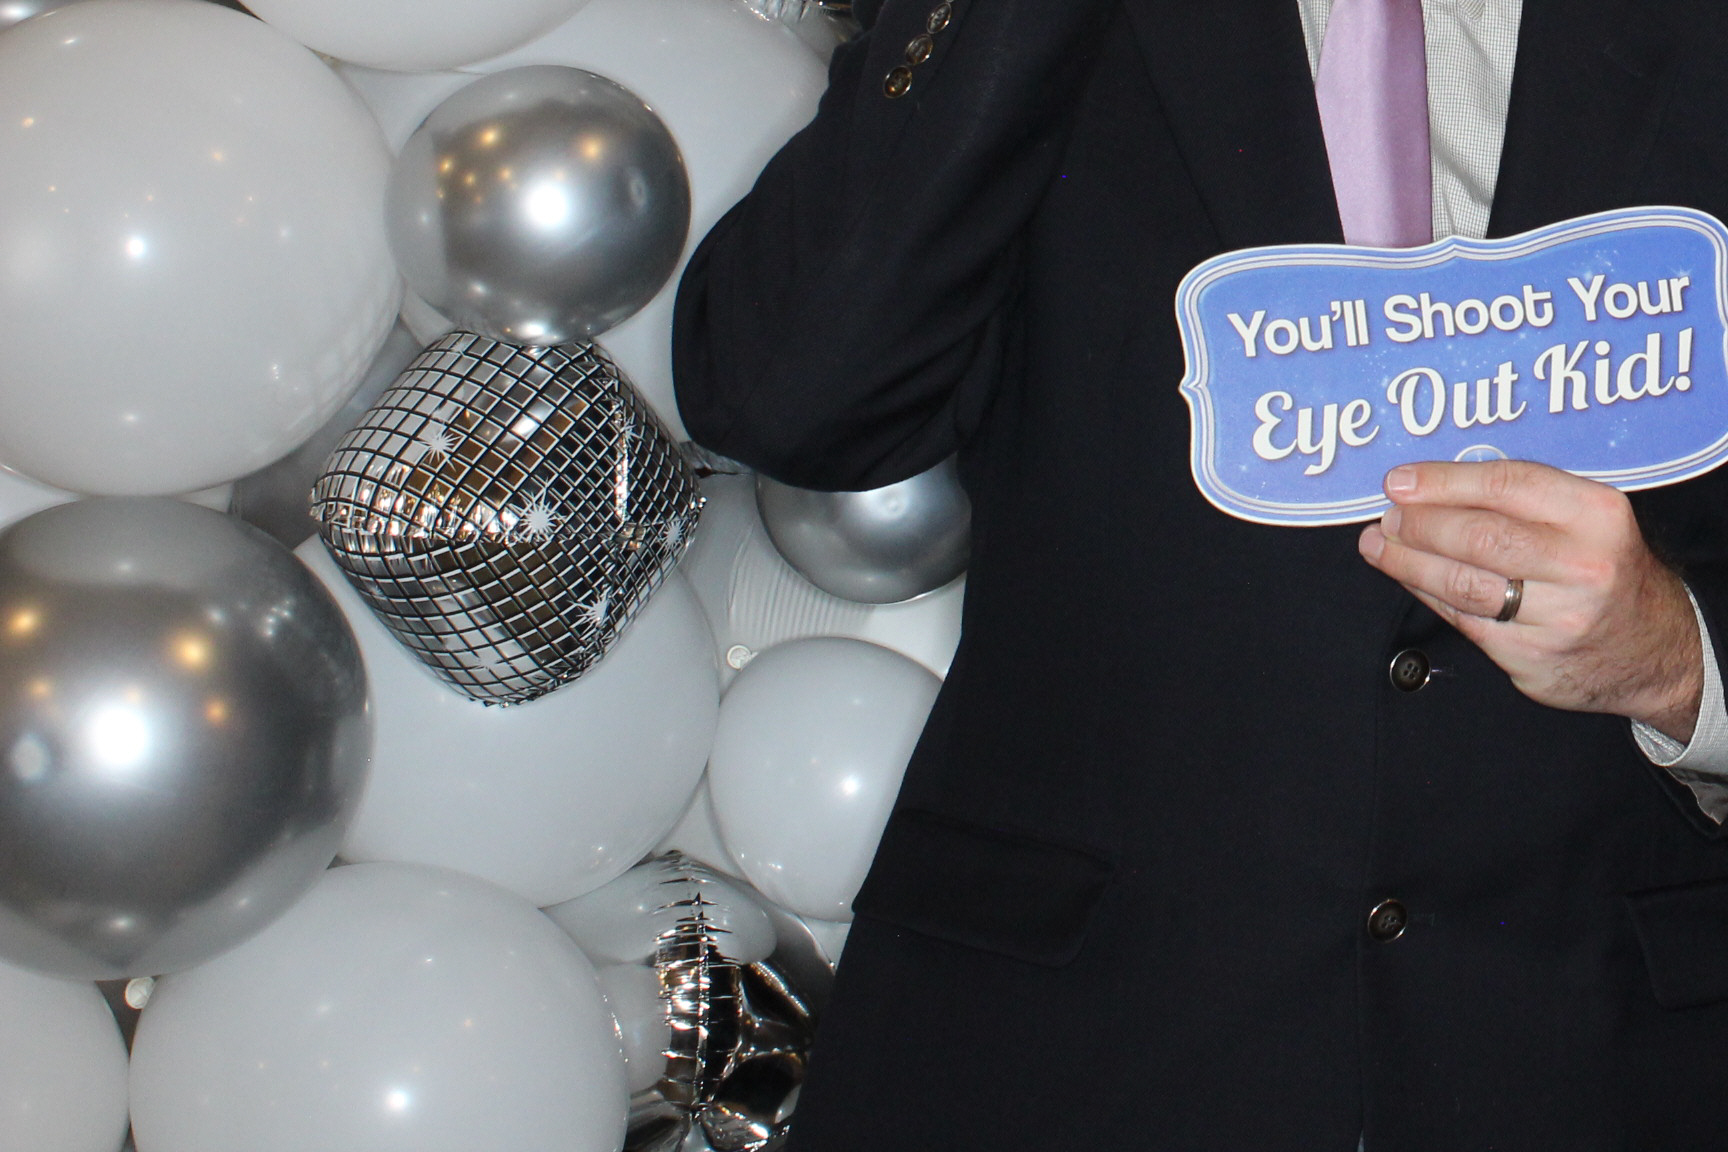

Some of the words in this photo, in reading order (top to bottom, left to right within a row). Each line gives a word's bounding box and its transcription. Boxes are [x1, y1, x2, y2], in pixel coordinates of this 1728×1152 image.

[1227, 300, 1369, 358] You'll
[1384, 284, 1554, 343] Shoot
[1566, 274, 1690, 321] Your
[1252, 391, 1380, 476] Eye
[1386, 359, 1527, 436] Out
[1533, 327, 1694, 414] Kid!
